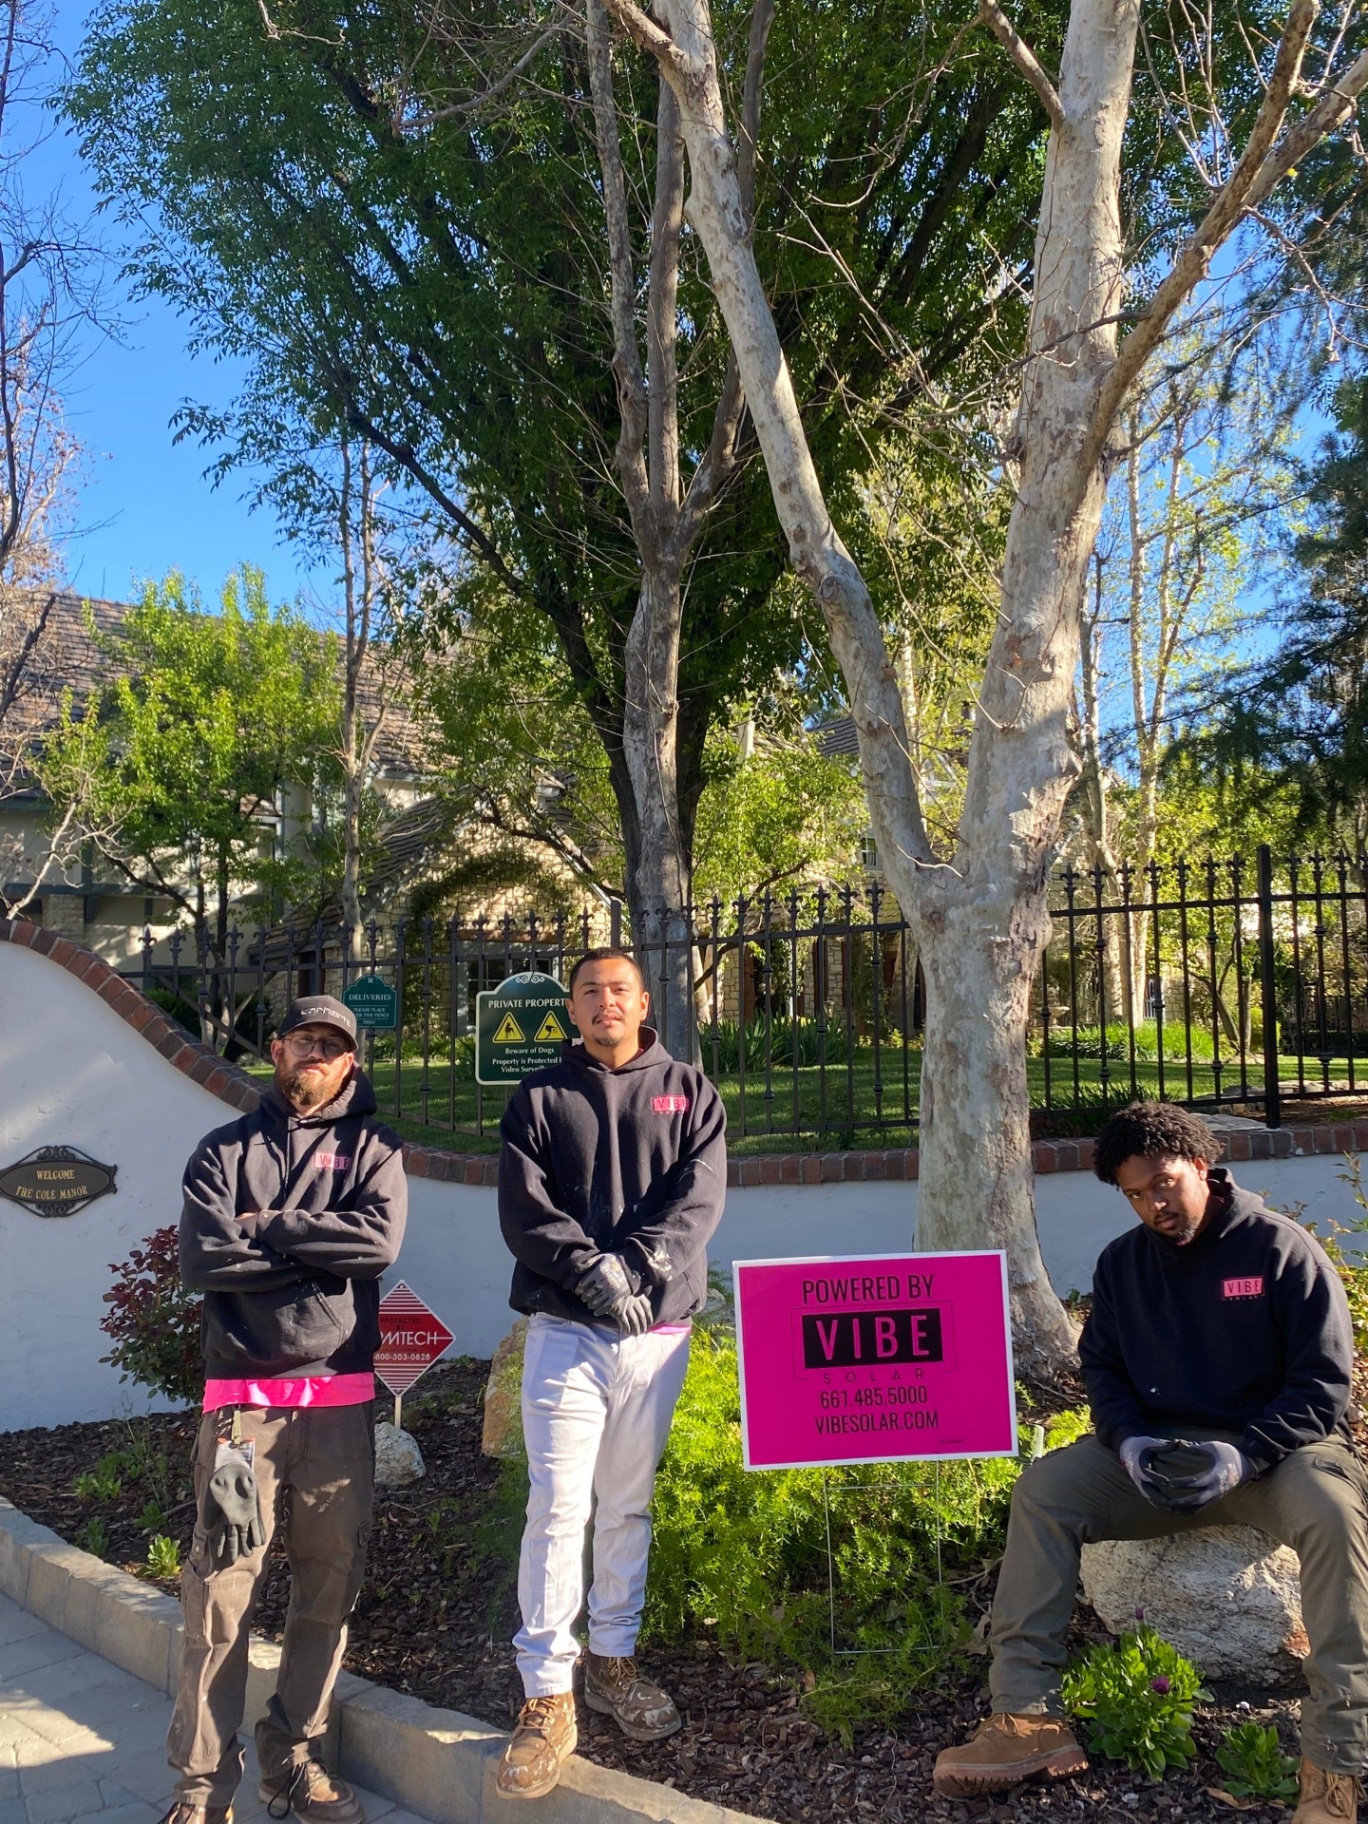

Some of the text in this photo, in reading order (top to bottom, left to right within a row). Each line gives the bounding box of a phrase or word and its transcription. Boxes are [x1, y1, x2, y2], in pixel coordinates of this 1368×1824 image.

[488, 998, 565, 1009] PRIVATE PROPERT
[301, 1007, 350, 1027] carhartt
[505, 1047, 529, 1055] Beware
[538, 1047, 554, 1055] Dogs
[36, 1169, 75, 1180] WELCOME
[15, 1185, 88, 1200] THE COLE MANOR
[802, 1274, 934, 1304] POWERED BY
[1227, 1280, 1260, 1294] VIBE
[380, 1331, 438, 1346] MTECH
[816, 1315, 930, 1361] VIBE
[823, 1368, 924, 1384] SOLAR
[820, 1385, 928, 1409] 661.485.5000
[815, 1410, 939, 1434] VIBESOLAR.COM
